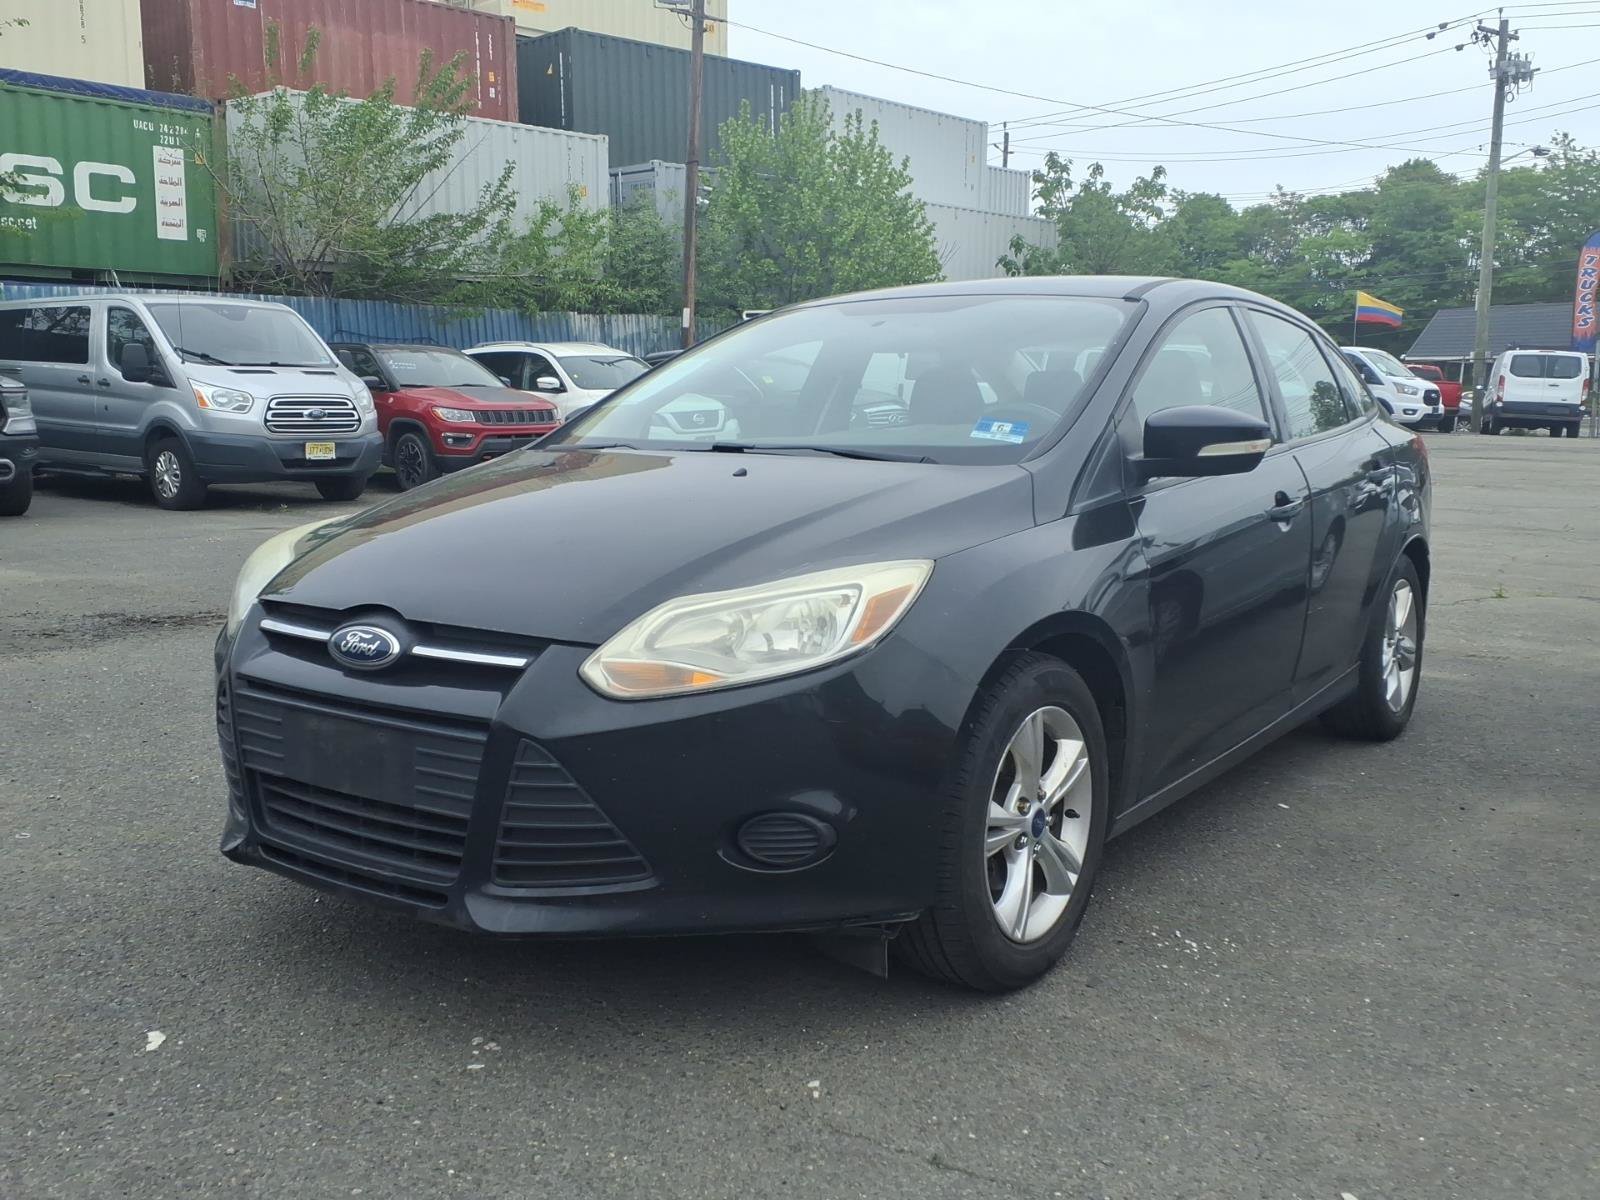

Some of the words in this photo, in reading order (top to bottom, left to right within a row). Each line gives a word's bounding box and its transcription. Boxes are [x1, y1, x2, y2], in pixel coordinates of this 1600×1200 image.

[133, 119, 154, 131] UACU
[1577, 254, 1599, 329] TRUCKS
[340, 631, 380, 657] Ford
